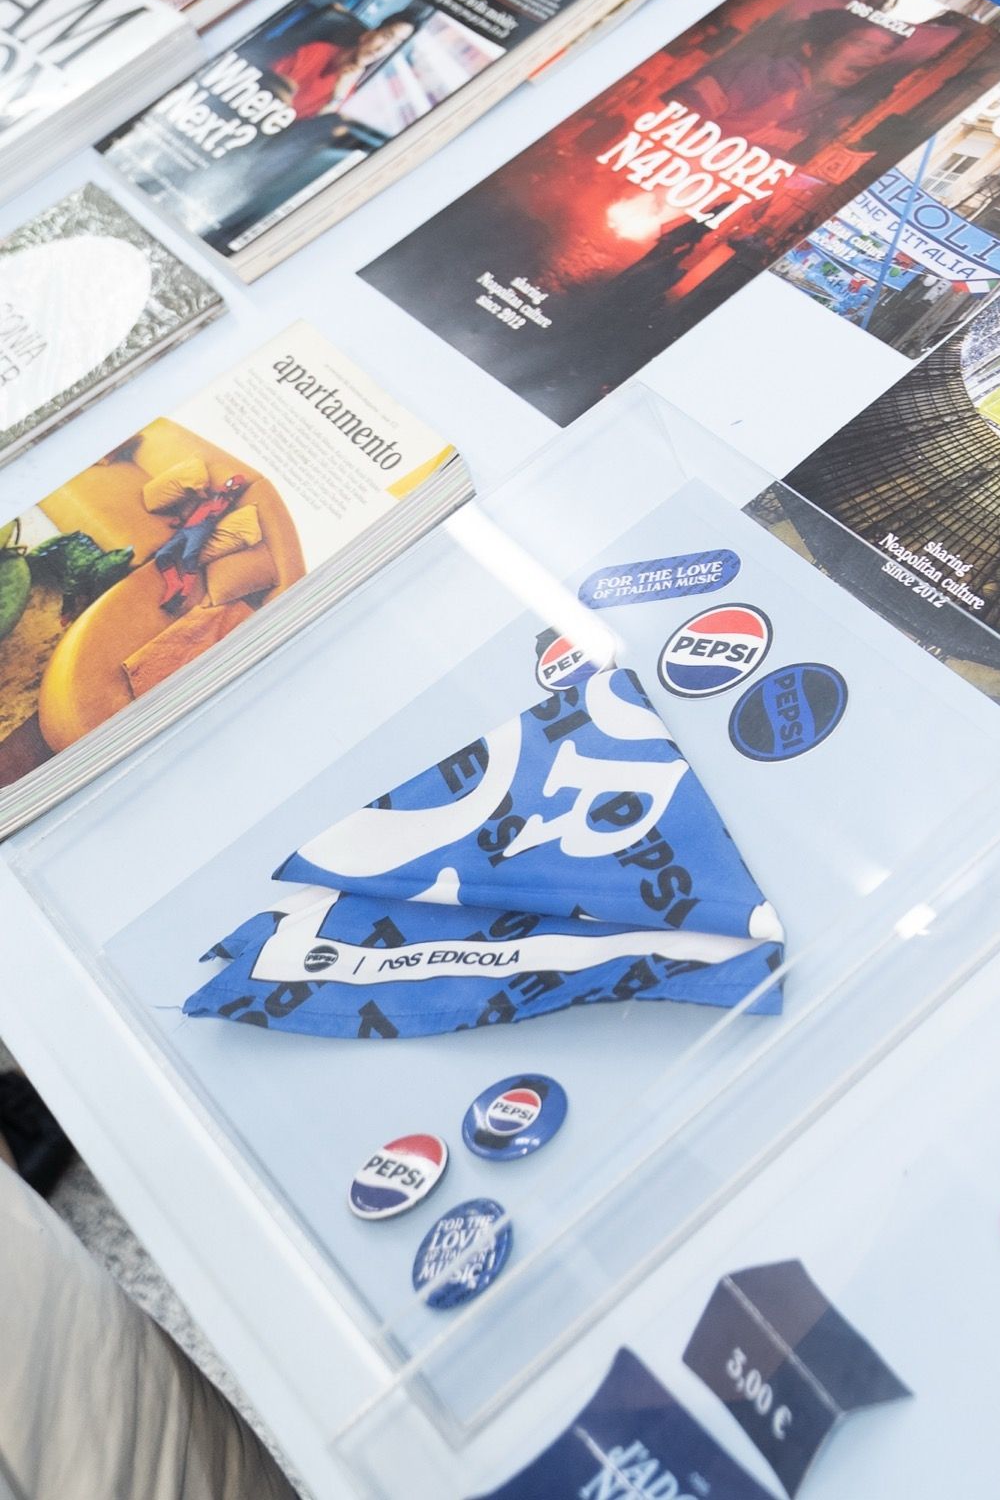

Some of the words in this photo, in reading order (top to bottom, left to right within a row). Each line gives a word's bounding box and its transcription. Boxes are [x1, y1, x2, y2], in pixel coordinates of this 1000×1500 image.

[866, 10, 916, 38] EDICOLA
[201, 50, 297, 135] Where
[152, 81, 257, 159] Next?
[634, 100, 796, 200] J'ADORE
[596, 131, 752, 230] N4POLI
[497, 307, 527, 330] 2012
[272, 354, 403, 472] apartamento
[597, 574, 634, 590] FOR
[637, 569, 674, 585] THE
[676, 560, 724, 579] LOVE
[878, 532, 943, 583] Neapolitan
[941, 578, 985, 610] culture
[923, 541, 973, 577] sharing
[592, 587, 613, 600] OF
[615, 578, 673, 597] ITALIAN
[674, 571, 723, 590] MUSIC
[881, 561, 915, 587] since
[912, 581, 951, 609] 2012
[671, 635, 760, 665] PEPSI
[775, 672, 805, 751] PEPSI
[306, 952, 337, 963] PEPSI
[427, 949, 520, 968] EDICOLA
[492, 1100, 535, 1122] PEPSI
[362, 1154, 426, 1191] PEPSI
[437, 1217, 464, 1232] FOR
[725, 1347, 774, 1417] 3,00
[772, 1405, 793, 1441] €
